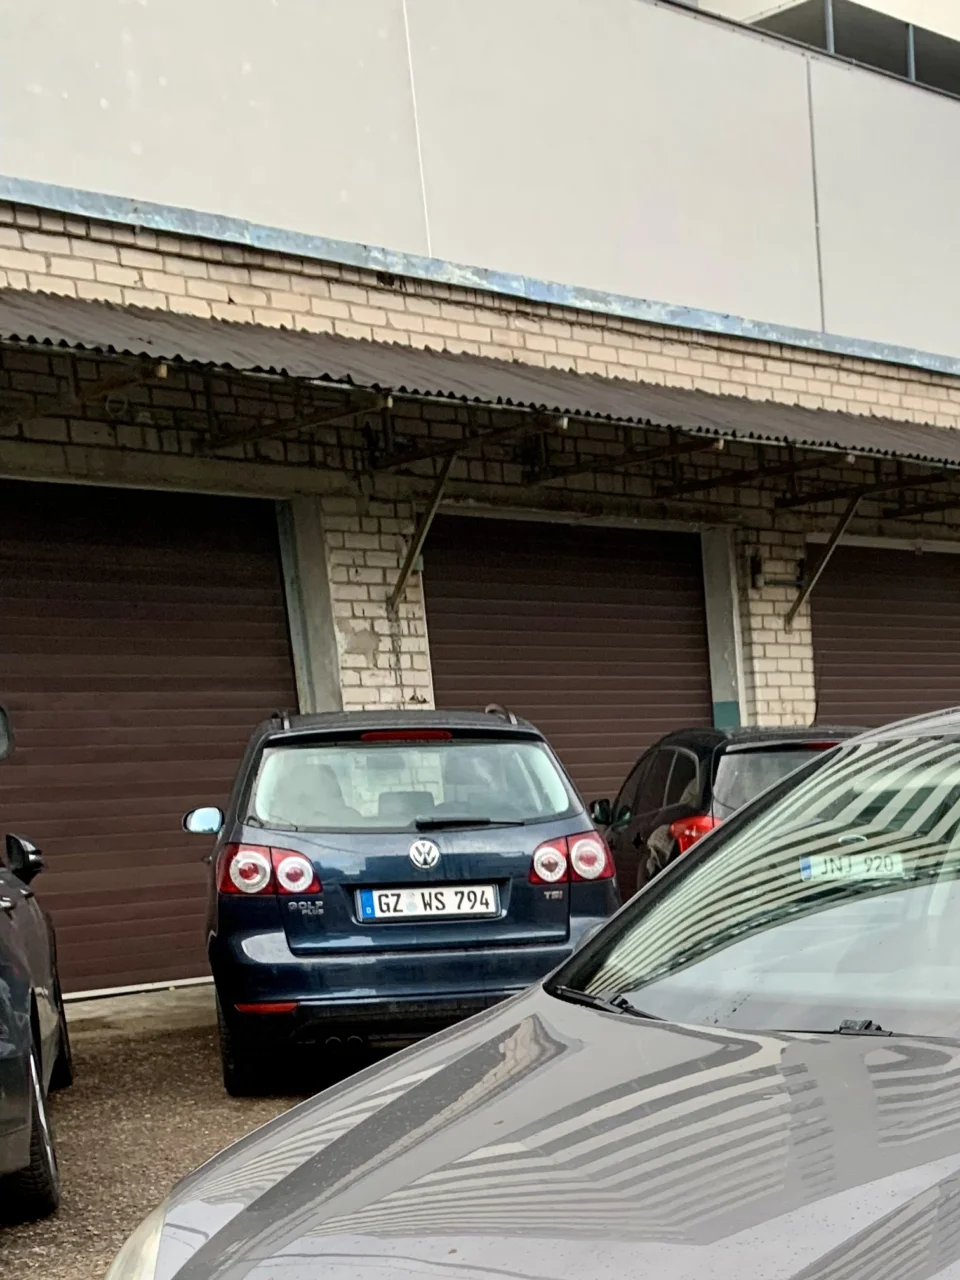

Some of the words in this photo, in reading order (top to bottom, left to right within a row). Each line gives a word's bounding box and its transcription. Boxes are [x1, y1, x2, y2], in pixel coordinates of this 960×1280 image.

[864, 854, 894, 873] 920
[288, 901, 324, 911] GOLF
[378, 893, 403, 913] GZ
[421, 891, 446, 912] WS
[454, 890, 490, 910] 794
[302, 908, 324, 916] PLUS
